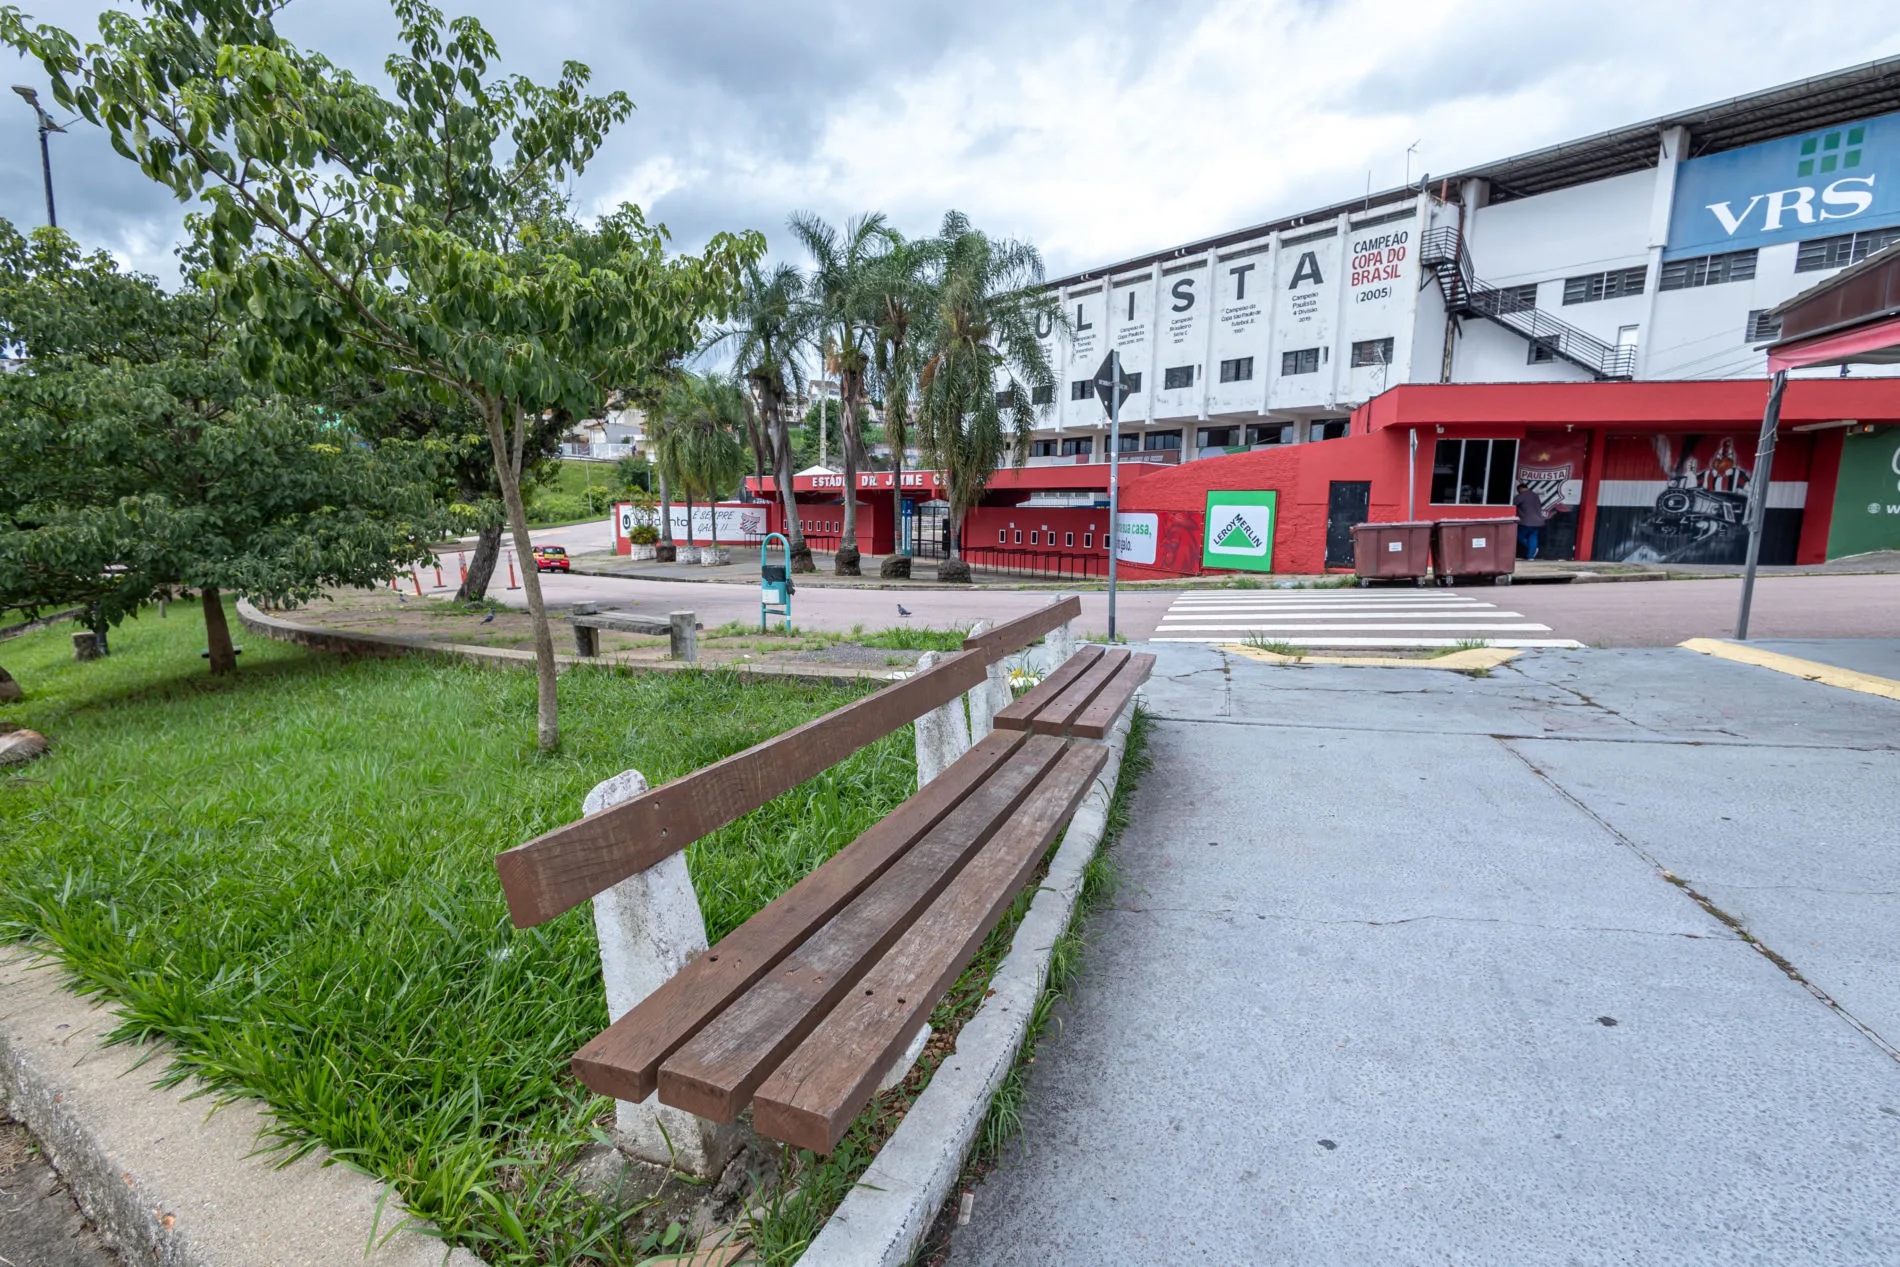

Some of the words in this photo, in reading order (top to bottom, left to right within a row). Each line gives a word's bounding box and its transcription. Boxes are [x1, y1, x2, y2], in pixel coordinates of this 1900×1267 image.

[1705, 174, 1875, 236] VRS
[1354, 230, 1408, 254] CAMPEÃO
[1352, 251, 1383, 270] COPA
[1387, 246, 1406, 264] DO
[1351, 263, 1401, 287] BRASIL
[1292, 300, 1317, 309] Paulista
[1356, 285, 1392, 305] (2005)
[812, 473, 845, 487] ESTÁDI
[885, 473, 923, 487] JYME
[1521, 470, 1565, 480] PAULISTA
[1131, 523, 1152, 539] casa,
[1213, 519, 1237, 545] LEROY
[1234, 513, 1263, 548] MERLIN
